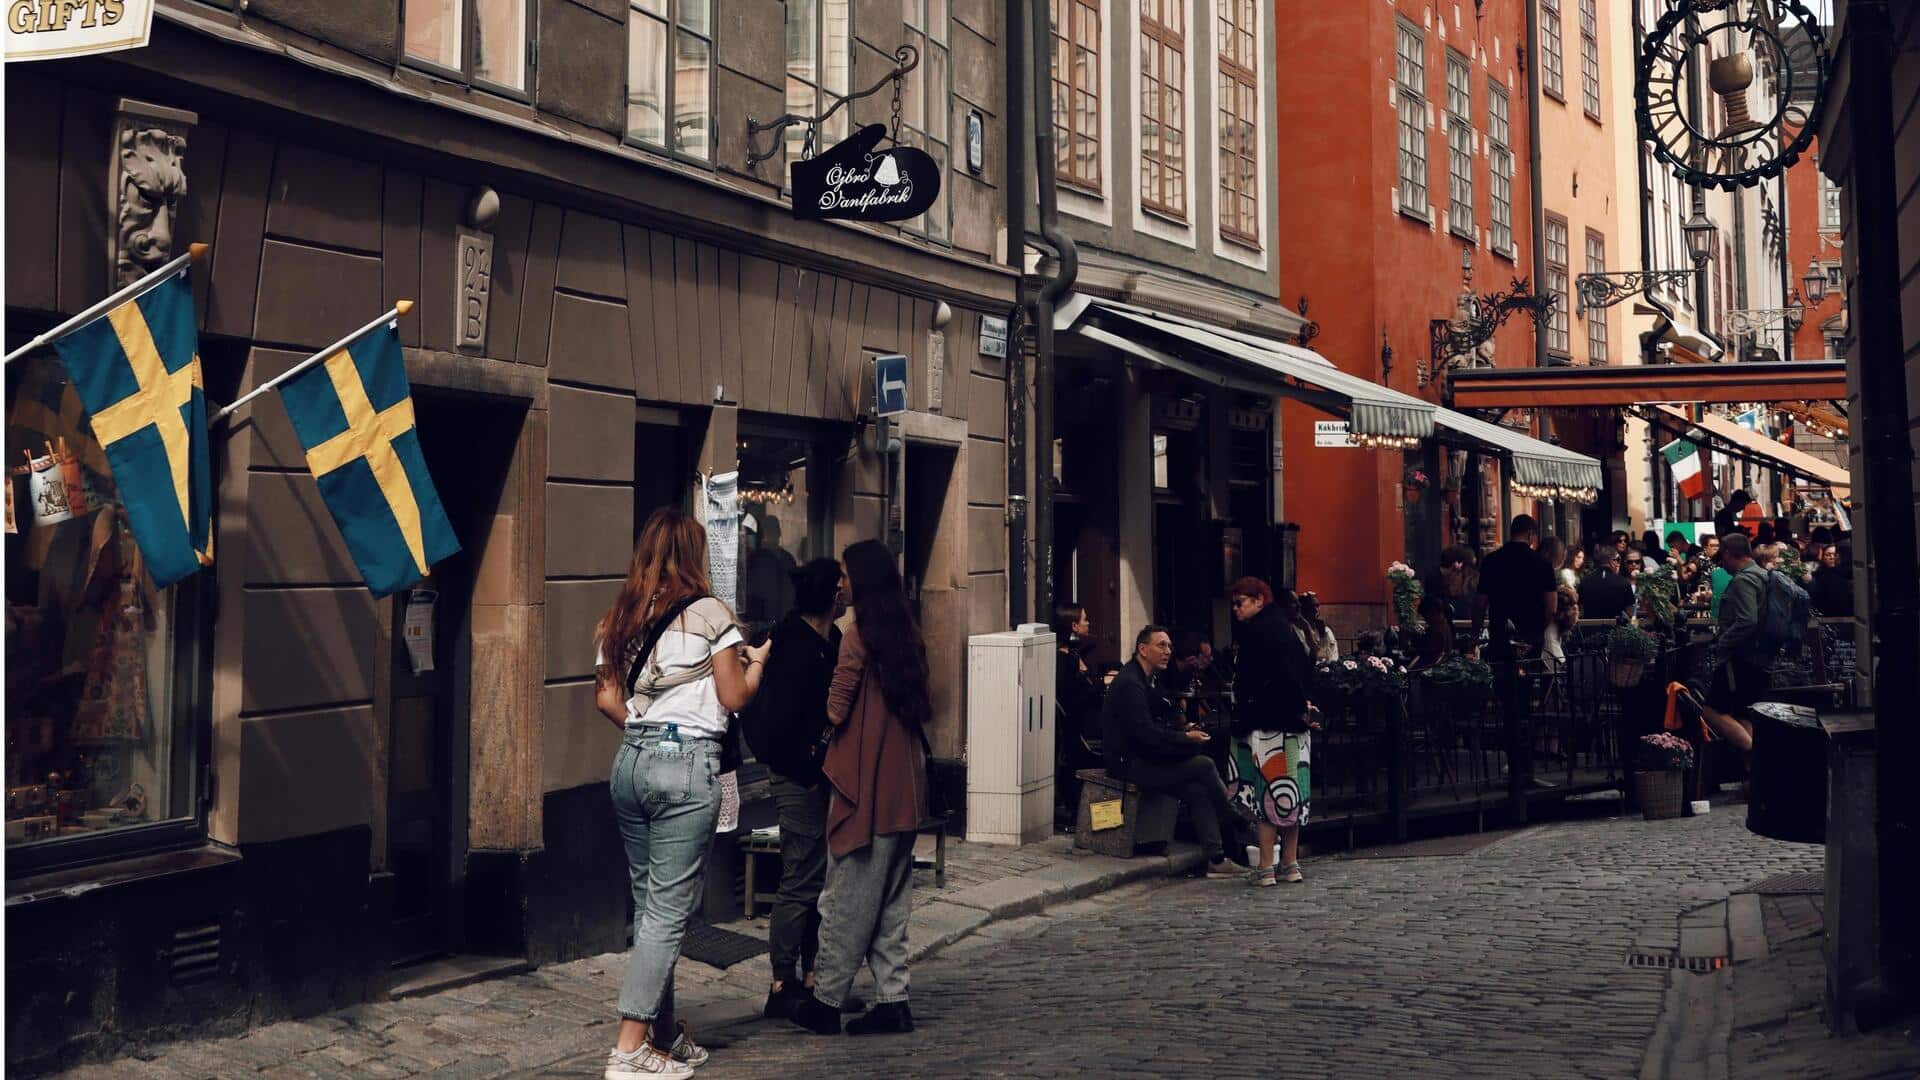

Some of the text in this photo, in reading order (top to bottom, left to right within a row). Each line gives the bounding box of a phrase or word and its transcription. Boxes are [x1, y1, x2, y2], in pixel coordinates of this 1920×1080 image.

[8, 0, 125, 34] GIFTS
[826, 163, 869, 192] Öjbro
[819, 187, 909, 213] Vantfabrik
